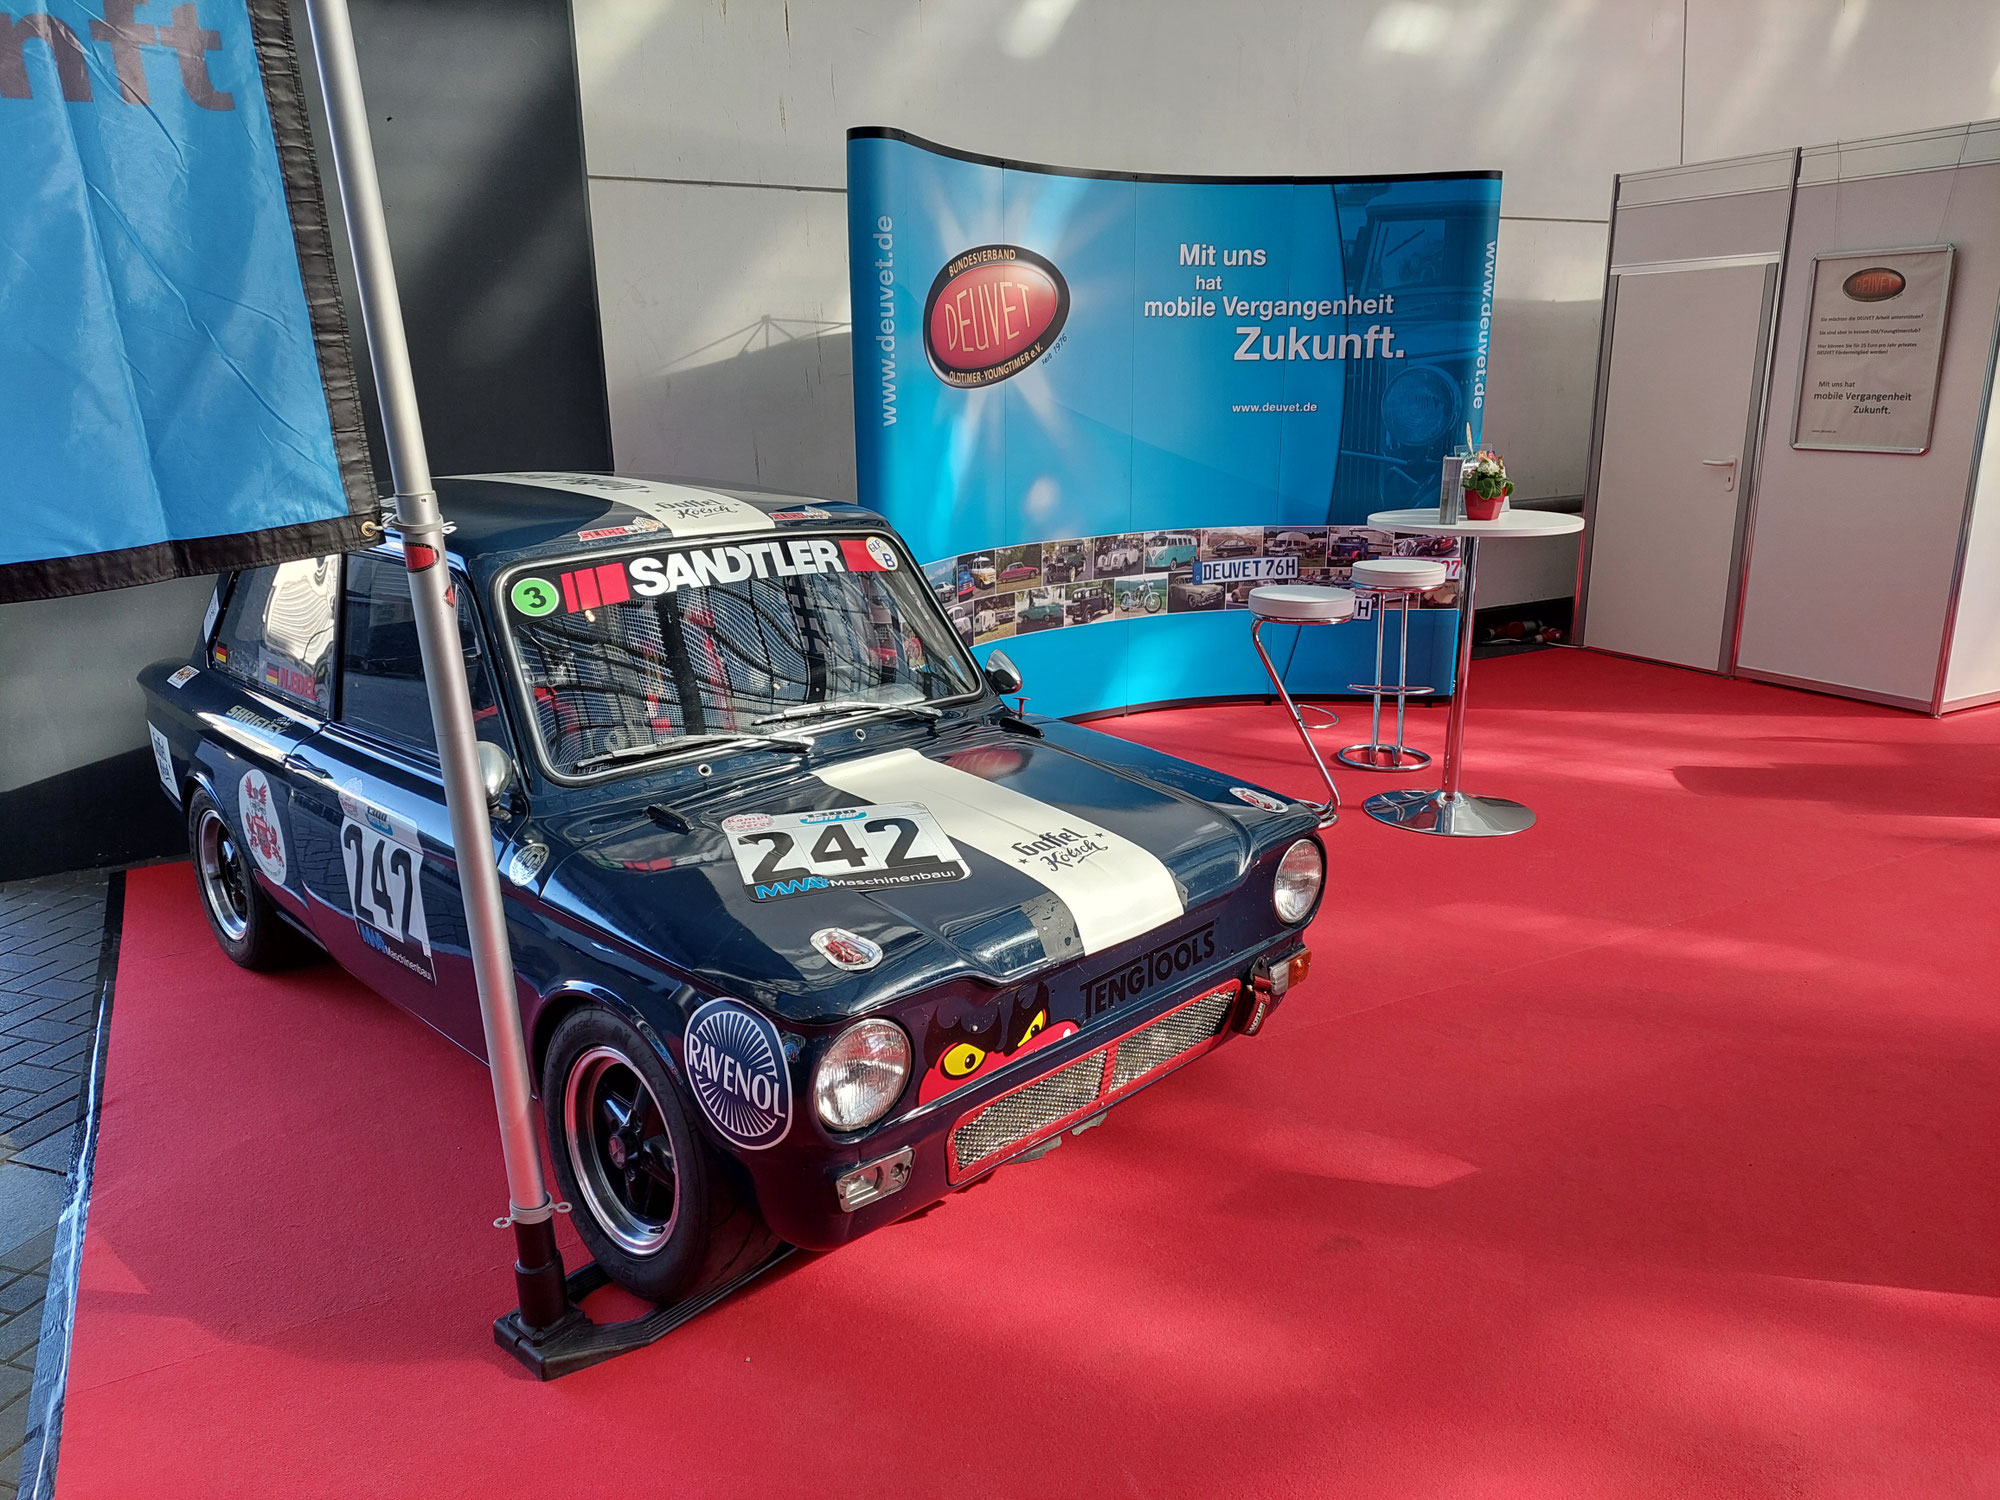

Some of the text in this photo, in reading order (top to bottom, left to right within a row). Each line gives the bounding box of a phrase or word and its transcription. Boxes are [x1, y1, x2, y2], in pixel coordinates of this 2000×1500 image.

[948, 249, 1016, 277] BUNDESVERBAND
[1179, 244, 1267, 267] Mit uns
[1195, 275, 1223, 291] hat
[1855, 275, 1894, 293] DEUVET
[873, 215, 897, 427] www.deuvet.de
[945, 281, 1030, 352] DEUVET
[1144, 294, 1395, 321] mobile Vergangenheit
[1473, 240, 1498, 410] www.deuvet.de
[1030, 342, 1044, 358] e.V.
[1041, 333, 1068, 366] seit 1976
[1234, 325, 1405, 362] Zukunft.
[1232, 402, 1318, 414] www.deuvet.de
[1813, 391, 1912, 402] mobile Vergangenheit
[1853, 405, 1891, 415] Zukunft.
[628, 540, 845, 597] SANDTLER
[882, 553, 896, 568] B
[1203, 558, 1297, 581] DEUVET 76H
[523, 587, 546, 608] 3
[739, 817, 956, 884] 242
[1011, 827, 1088, 856] Gaffel
[1040, 840, 1108, 871] Kölsch
[343, 824, 427, 956] 242
[1079, 920, 1215, 1019] TENGTOOLS
[688, 1033, 786, 1118] RAVENOL
